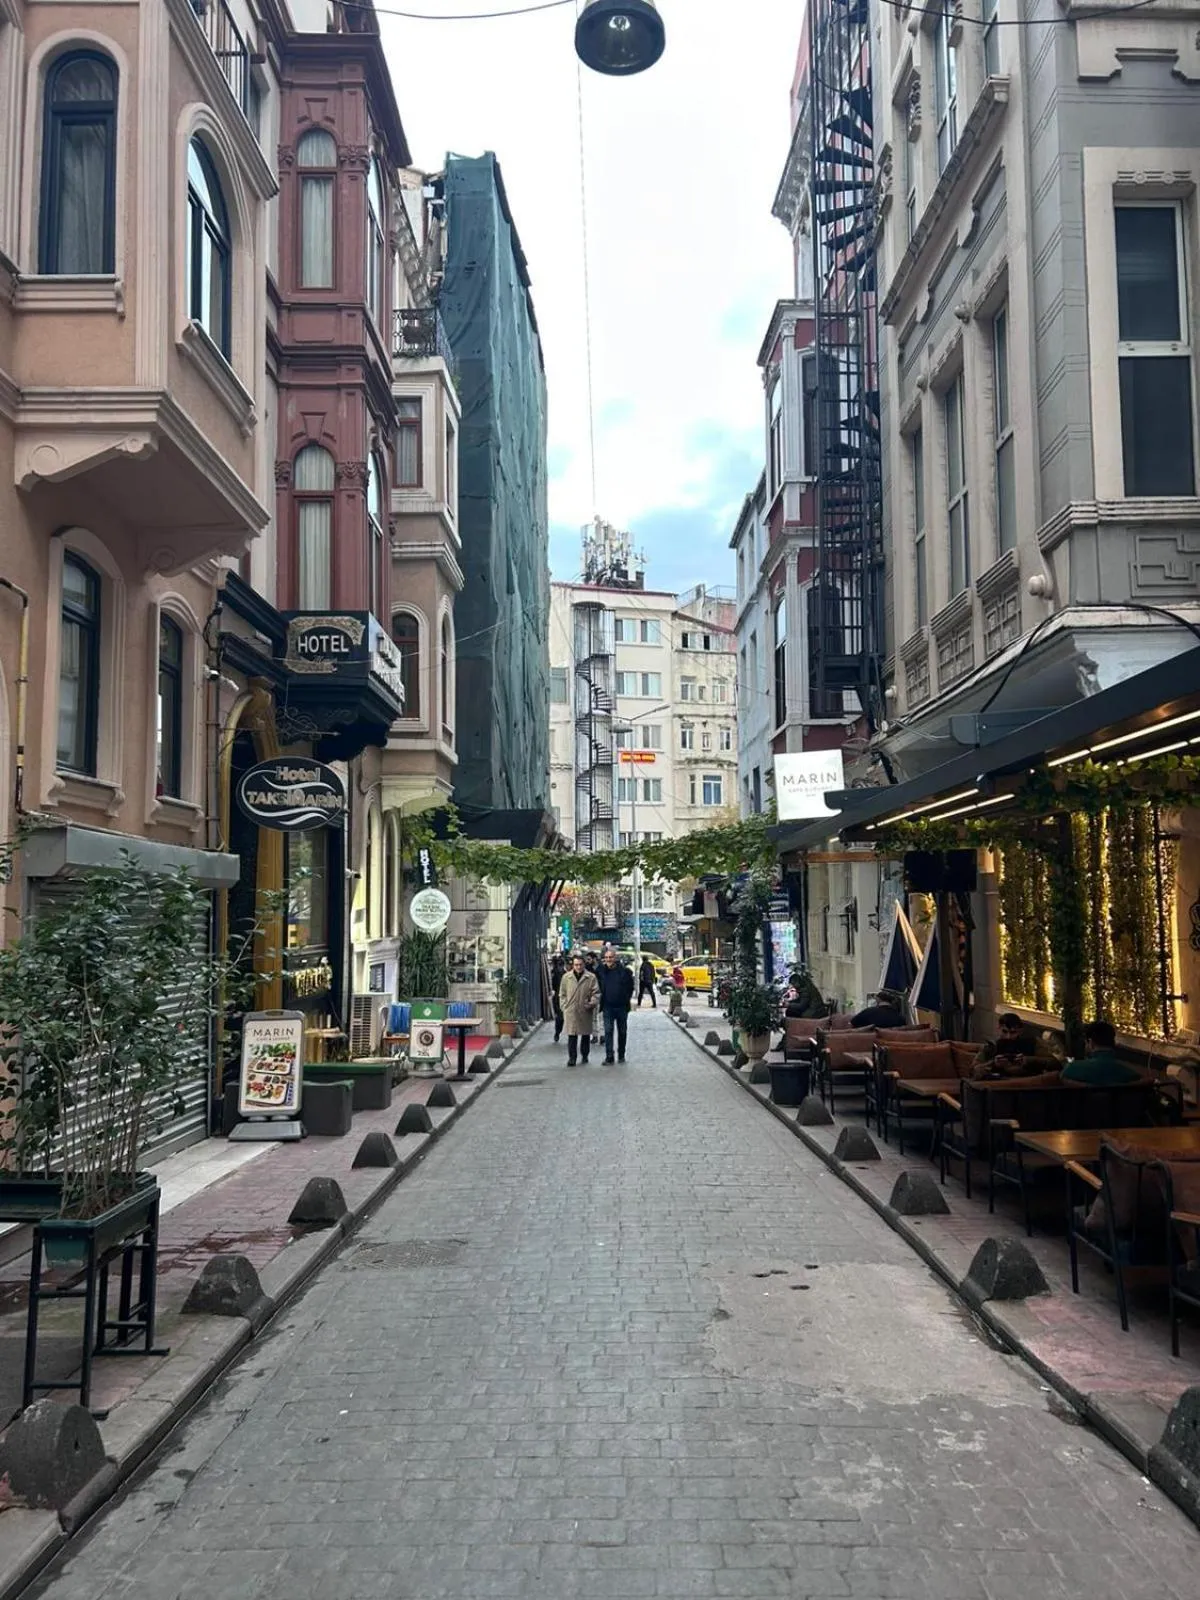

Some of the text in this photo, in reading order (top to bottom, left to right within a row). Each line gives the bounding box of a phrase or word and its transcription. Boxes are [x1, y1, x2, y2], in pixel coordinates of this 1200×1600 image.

[297, 635, 349, 653] HOTEL
[276, 766, 320, 781] Hotel
[783, 772, 837, 786] MARIN
[420, 849, 431, 883] HOTEL
[253, 1027, 294, 1037] MARIN
